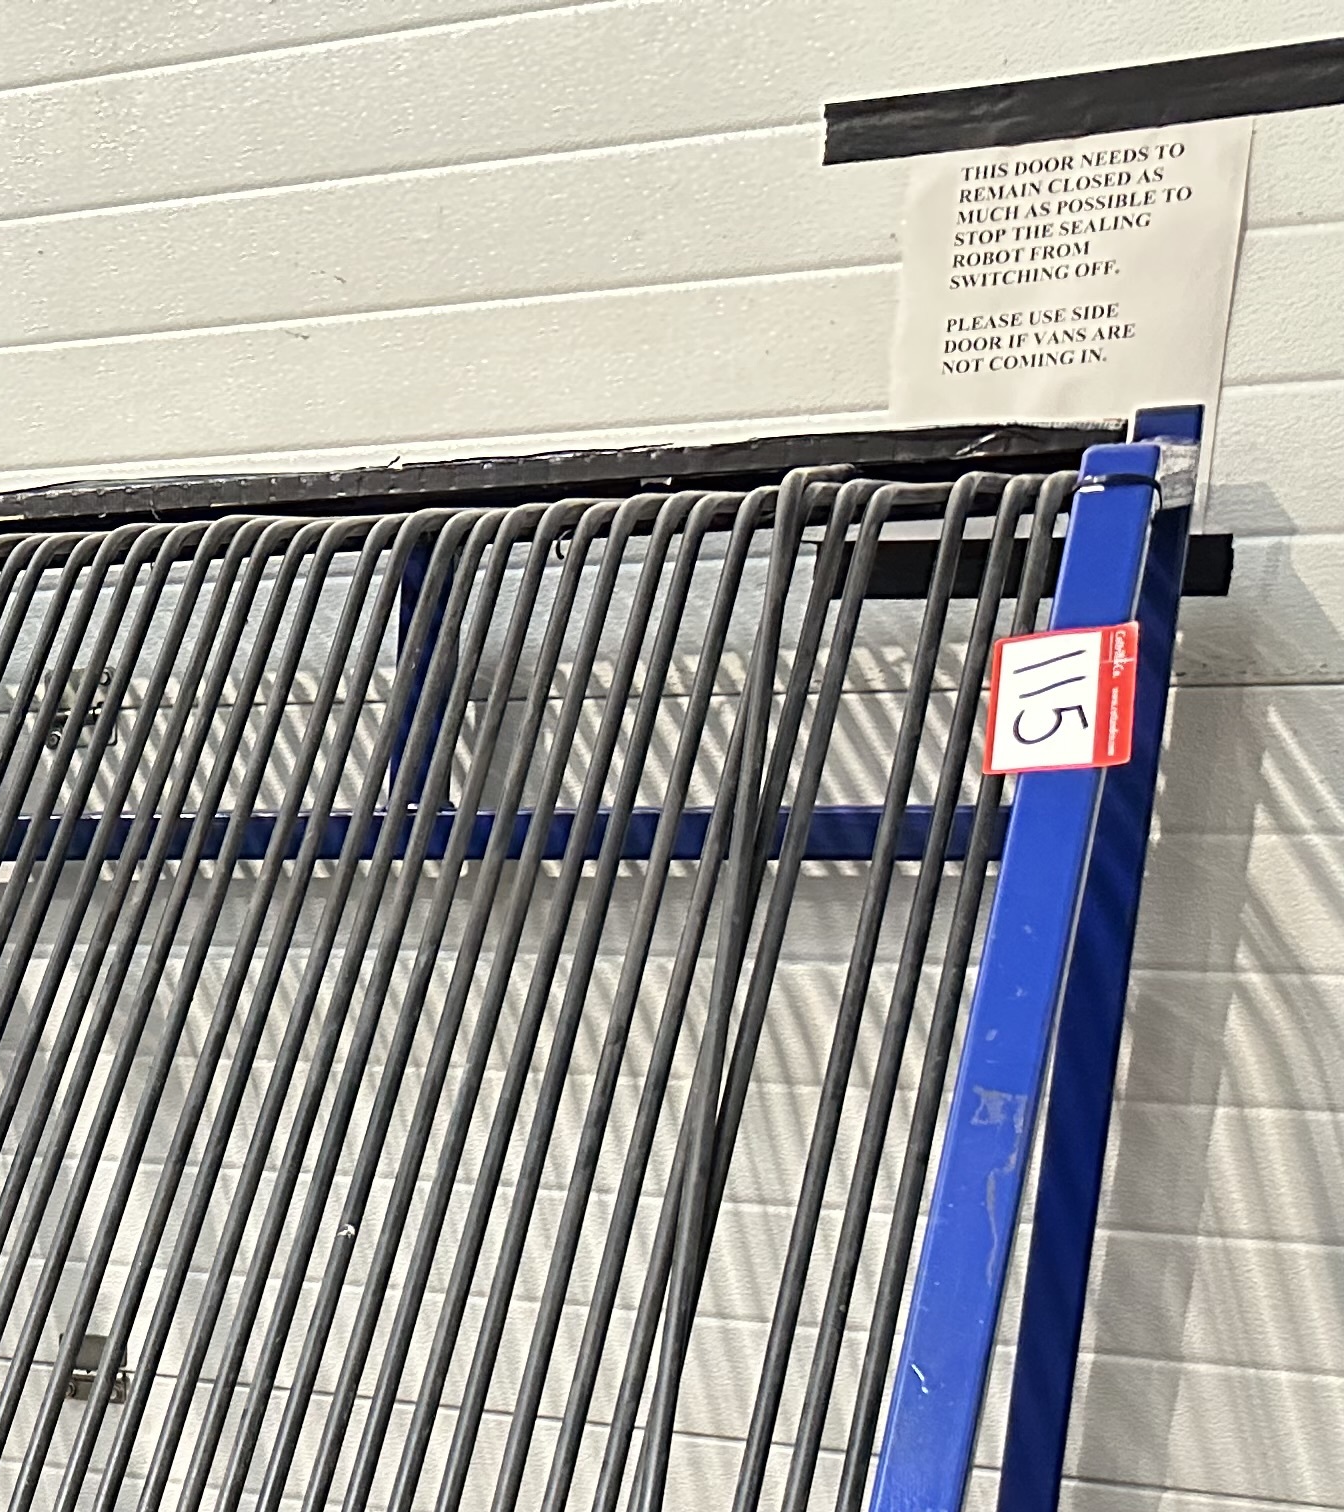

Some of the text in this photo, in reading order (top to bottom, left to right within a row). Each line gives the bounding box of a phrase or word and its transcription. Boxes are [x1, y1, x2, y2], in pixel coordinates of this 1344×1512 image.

[962, 143, 1185, 181] THIS DOOR NEEDS TO
[960, 167, 1164, 203] REMAIN CLOSED AS
[958, 187, 1192, 224] MUCH AS POSSIBLE TO
[954, 213, 1151, 246] STOP THE SEALING
[953, 241, 1090, 268] ROBOT FROM
[950, 260, 1120, 289] SWITCHING OFF.
[947, 303, 1119, 333] PLEASE USE SIDE
[944, 324, 1135, 354] DOOR IF VANS ARE
[942, 348, 1106, 374] NOT COMING IN.
[1012, 648, 1090, 745] 115
